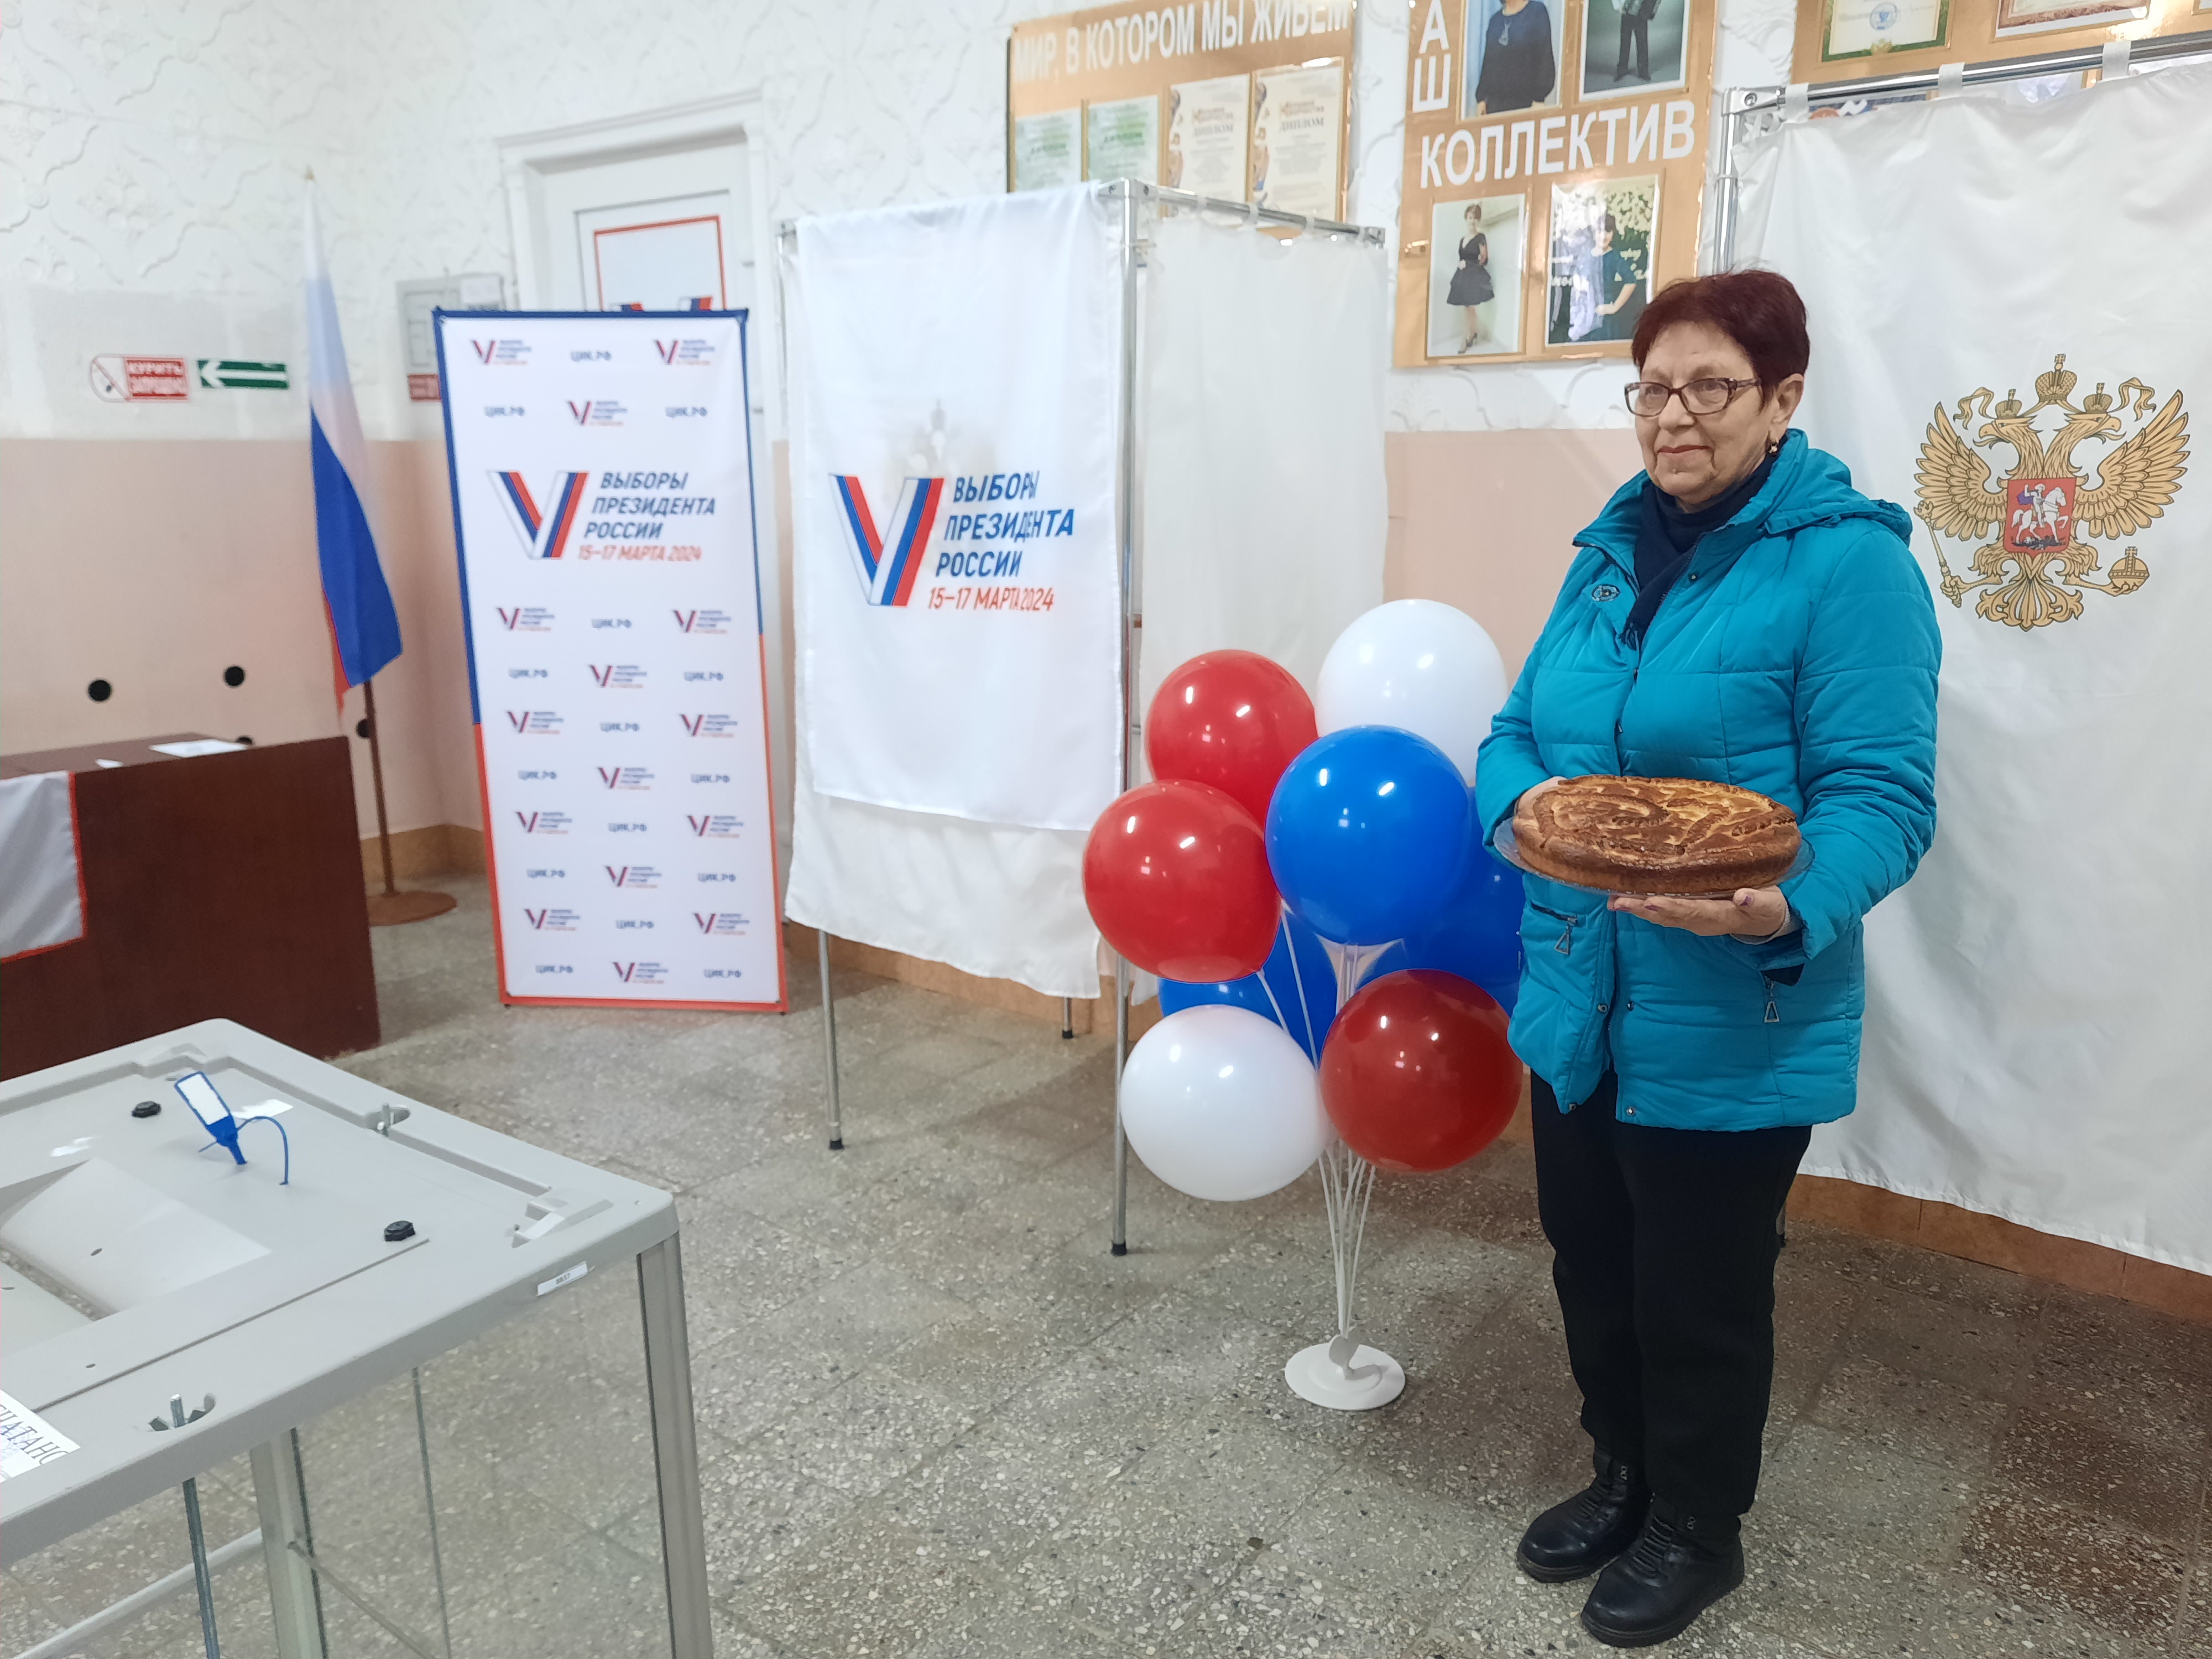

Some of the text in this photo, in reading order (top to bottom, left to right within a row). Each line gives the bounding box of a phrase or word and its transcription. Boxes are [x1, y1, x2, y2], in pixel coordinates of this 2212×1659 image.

[1066, 27, 1079, 75] В
[1086, 4, 1195, 71] КОТОРОМ
[1201, 0, 1244, 51] МЫ
[1420, 100, 1695, 189] КОЛЛЕКТИВ
[600, 471, 689, 491] ВЫБОРЫ
[592, 497, 716, 518] ПРЕЗИДЕНТА
[583, 521, 664, 540] РОССИИ
[617, 545, 667, 561] МАРТА
[667, 545, 702, 562] 2024
[935, 550, 1023, 578] РОССИИ
